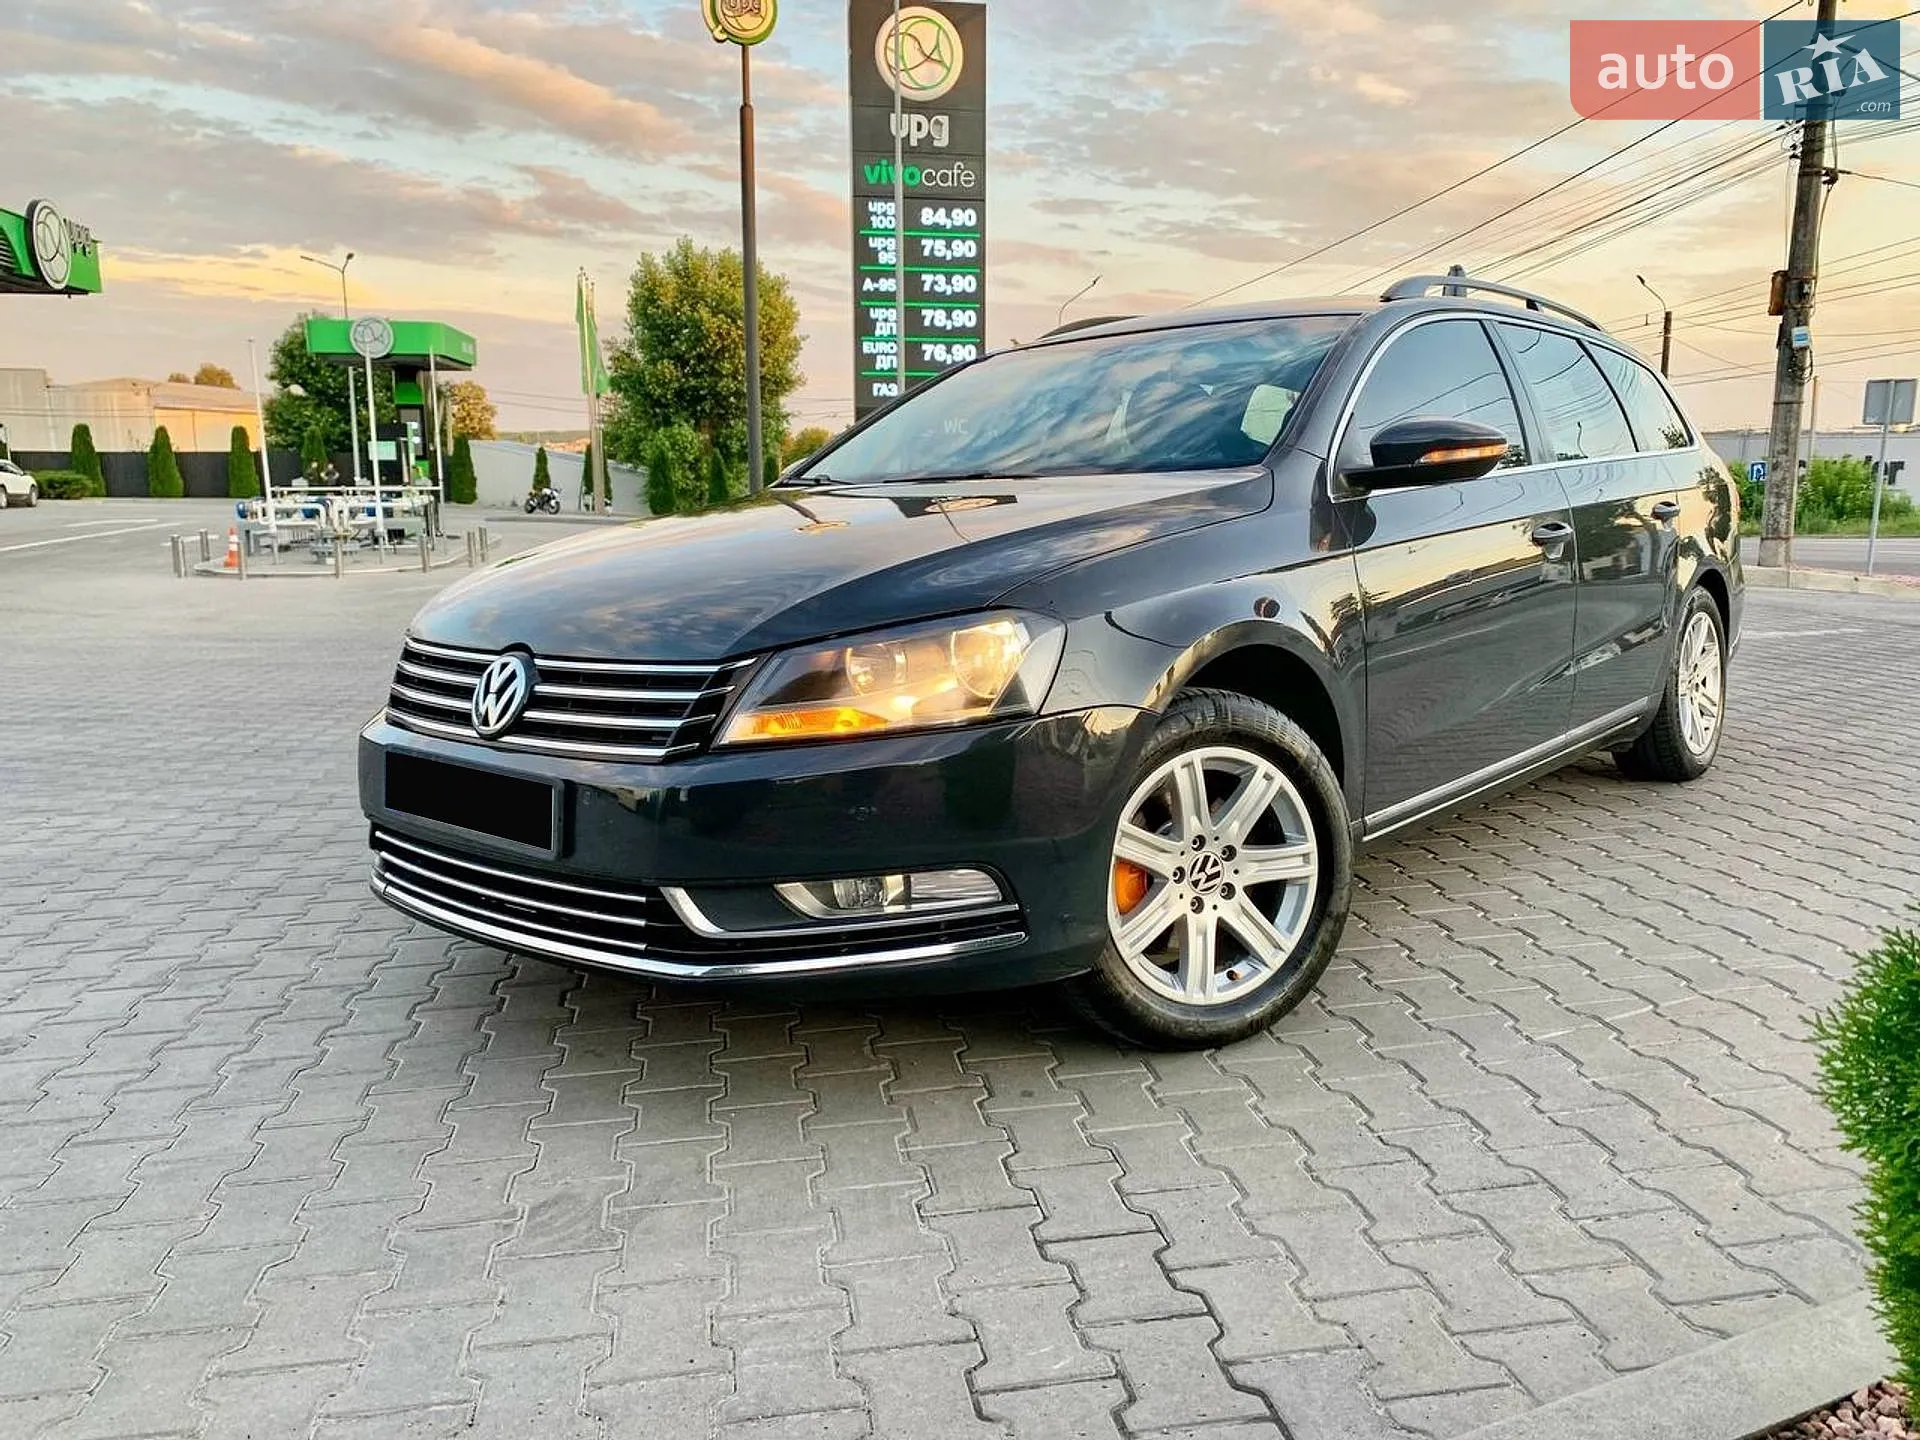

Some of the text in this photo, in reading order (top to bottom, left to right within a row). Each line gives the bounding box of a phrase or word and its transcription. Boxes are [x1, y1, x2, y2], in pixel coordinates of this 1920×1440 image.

[889, 112, 949, 147] upg
[868, 200, 896, 215] upg
[870, 215, 896, 229] 100
[920, 207, 977, 229] 84,90
[868, 236, 896, 251] upg
[920, 239, 977, 260] 75,90
[877, 251, 897, 265] 95
[920, 274, 977, 295] 73,90
[869, 307, 897, 321] upg
[920, 309, 977, 330] 78,90
[874, 321, 897, 337] ДП
[862, 341, 898, 354] EURO
[920, 344, 977, 364] 76,90
[874, 354, 898, 371] ДП
[872, 382, 899, 397] ГАЗ
[943, 418, 969, 435] WC
